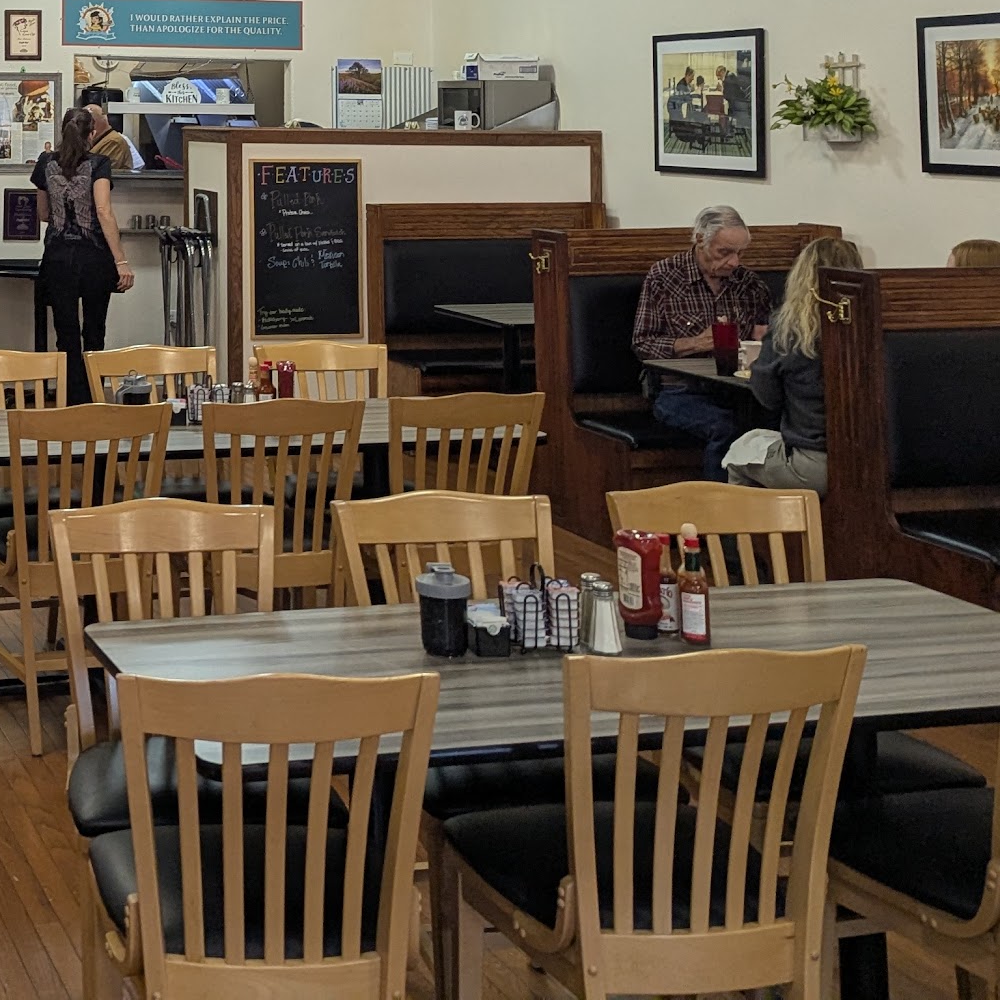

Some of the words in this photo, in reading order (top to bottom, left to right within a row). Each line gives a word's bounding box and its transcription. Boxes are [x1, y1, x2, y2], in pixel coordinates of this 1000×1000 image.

[135, 14, 168, 22] WOULD
[243, 16, 260, 24] THE
[262, 17, 289, 25] PRICE.
[156, 25, 205, 33] APOLOGIZE
[207, 26, 223, 34] FOR
[243, 27, 282, 35] QUALITY.
[166, 94, 197, 103] KITCHEN
